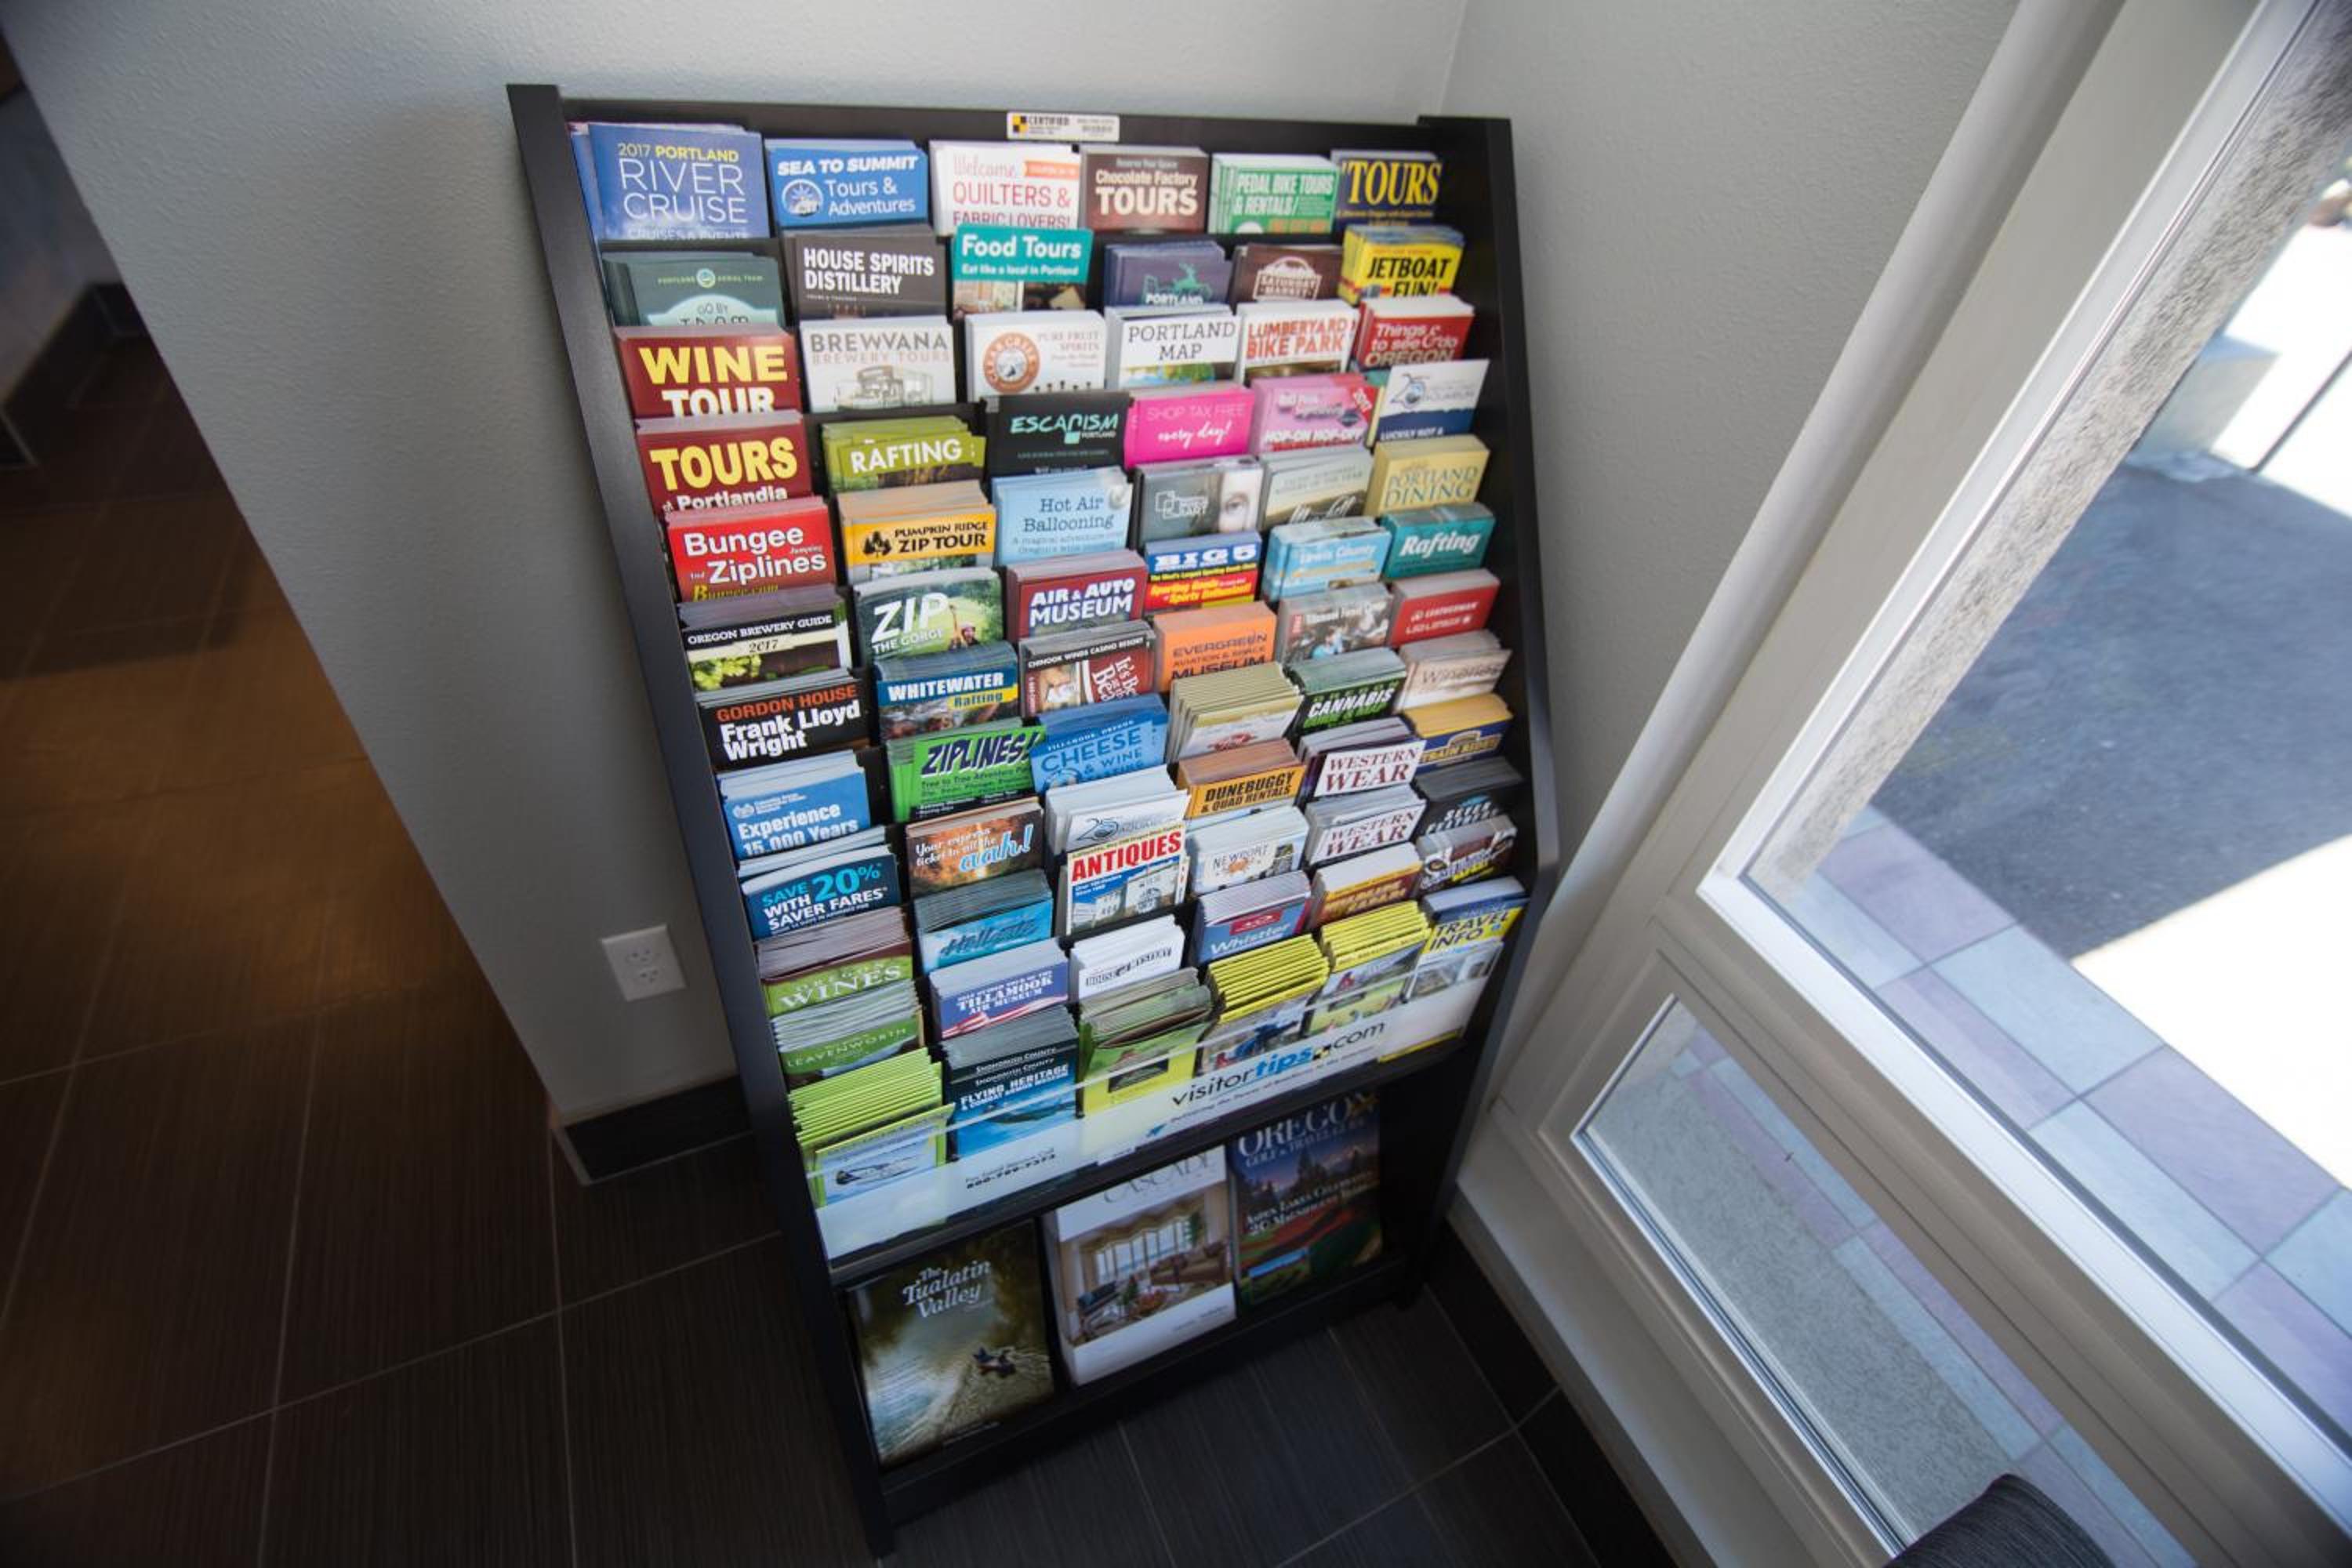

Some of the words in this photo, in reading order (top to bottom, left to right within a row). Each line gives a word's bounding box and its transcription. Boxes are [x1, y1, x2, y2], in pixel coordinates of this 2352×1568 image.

[618, 143, 651, 158] 2017
[655, 146, 739, 163] PORTLAND
[777, 159, 815, 176] SEA
[818, 158, 844, 172] TO
[846, 156, 919, 172] SUMMIT
[619, 158, 746, 195] RIVER
[825, 180, 878, 198] Tours
[882, 176, 898, 194] &
[1343, 160, 1442, 205] TOURS
[623, 192, 749, 223] CRUISE
[828, 198, 915, 216] Adventures
[953, 181, 1051, 205] QUILTERS
[1058, 187, 1071, 208] &
[1096, 187, 1197, 216] TOURS
[962, 234, 1017, 256] Food
[1023, 236, 1081, 259] Tours
[804, 248, 866, 271] HOUSE
[869, 252, 935, 276] SPIRITS
[962, 263, 977, 274] Eat
[1367, 256, 1453, 279] JETBOAT
[805, 270, 902, 295] DISTILLERY
[810, 331, 949, 352] BREWVANA
[1128, 321, 1236, 343] PORTLAND
[1248, 317, 1348, 339] LUMBERYARD
[1376, 322, 1428, 339] Things
[1160, 343, 1203, 360] MAP
[1247, 337, 1287, 359] BIKE
[1294, 336, 1345, 356] PARK
[1365, 349, 1454, 367] OREGON
[638, 346, 788, 384] WINE
[662, 387, 775, 419] TOUR
[649, 437, 798, 492] TOURS
[850, 438, 963, 474] RAFTING
[676, 485, 788, 510] Portlandia
[1040, 497, 1072, 513] Hot
[1076, 495, 1105, 511] Air
[1385, 482, 1472, 506] DINING
[895, 524, 951, 538] PUMPKIN
[954, 521, 988, 532] RIDGE
[1023, 515, 1115, 532] Ballooning
[684, 527, 804, 557] Bungee
[899, 539, 931, 554] ZIP
[932, 533, 986, 550] TOUR
[1399, 530, 1482, 559] Rafting
[706, 553, 827, 586] Ziplines
[1030, 590, 1067, 608] AIR
[1069, 589, 1084, 601] &
[1084, 578, 1136, 598] AUTO
[870, 593, 948, 644] ZIP
[1029, 593, 1134, 627] MUSEUM
[688, 630, 737, 645] OREGON
[740, 620, 796, 637] BREWERY
[797, 615, 832, 627] GUIDE
[873, 640, 899, 654] THE
[902, 629, 947, 646] GORGE
[749, 639, 779, 653] 2017
[1028, 655, 1062, 669] CHINOOK
[1090, 642, 1117, 655] CASINO
[1173, 633, 1268, 656] EVERGREEN
[887, 672, 1004, 702] WHITEWATER
[954, 692, 1003, 707] Rafting
[717, 697, 794, 722] GORDON
[797, 684, 856, 707] HOUSE
[1308, 688, 1396, 717] CANNABIS
[720, 714, 793, 743] Frank
[797, 699, 861, 730] Lloyd
[724, 729, 808, 761] Wright
[920, 731, 1041, 779] ZIPLINES!
[1041, 728, 1142, 772] CHEESE
[1330, 746, 1420, 771] WESTERN
[1083, 764, 1095, 775] &
[1101, 748, 1142, 768] WINE
[1204, 771, 1296, 802] DUNEBUGGY
[1325, 764, 1410, 793] WEAR
[1211, 797, 1243, 811] QUAD
[1246, 786, 1293, 802] RENTALS
[739, 804, 841, 840] Experience
[807, 819, 859, 841] Years
[1330, 810, 1420, 840] WESTERN
[916, 842, 943, 857] Your
[958, 823, 1035, 873] aah!
[1325, 824, 1408, 855] WEAR
[1071, 830, 1181, 883] ANTIQUES
[1212, 844, 1269, 871] NEWPORT
[762, 880, 808, 907] SAVE
[763, 894, 811, 918] WITH
[768, 902, 826, 931] SAVER
[780, 964, 902, 1008] WINES
[957, 973, 1054, 1011] TILLAMOOK
[970, 999, 991, 1015] AIR
[994, 987, 1044, 1007] MUSEUM
[786, 1026, 908, 1068] LEAVENWORTH
[1024, 1048, 1057, 1061] COUNTY
[1172, 1022, 1386, 1106] visitortips.com
[961, 1083, 1005, 1110] FLYING
[1009, 1064, 1069, 1091] HERITAGE
[902, 1260, 992, 1305] Tualatin
[919, 1267, 942, 1280] The
[918, 1283, 982, 1318] Valley
